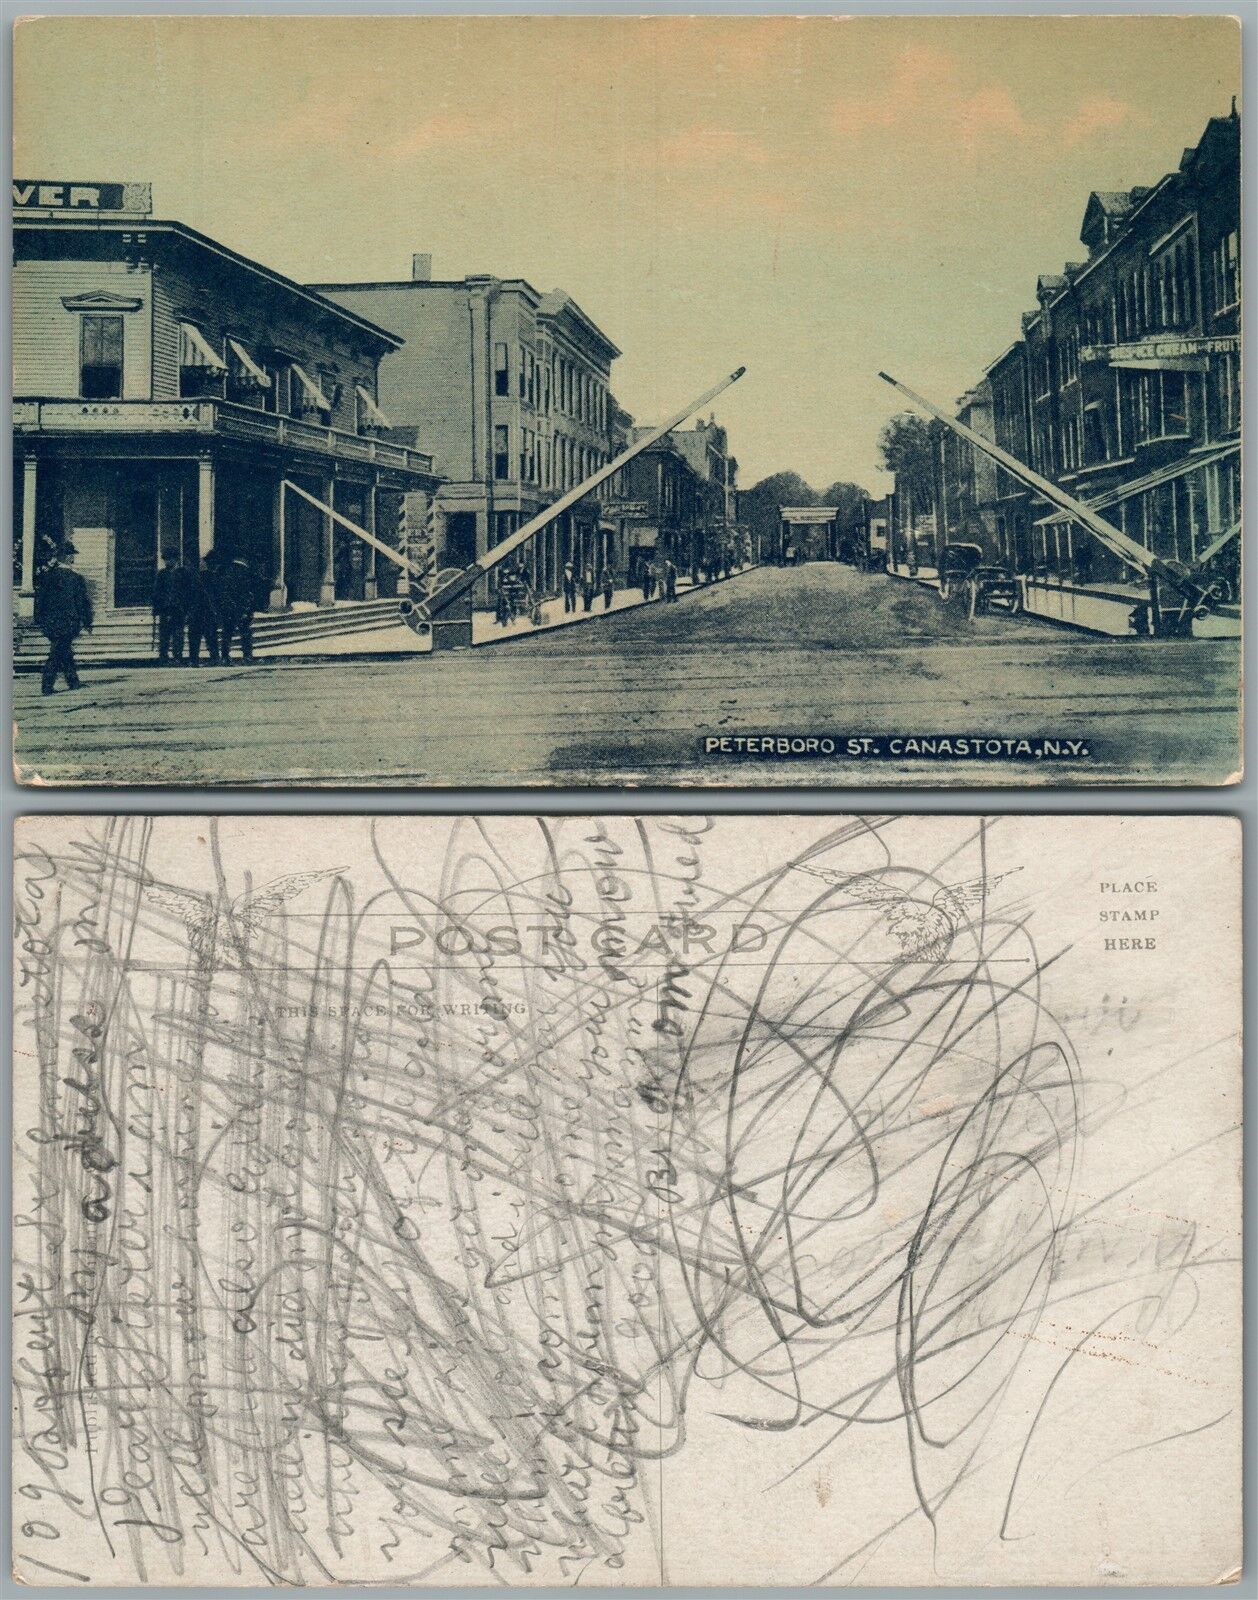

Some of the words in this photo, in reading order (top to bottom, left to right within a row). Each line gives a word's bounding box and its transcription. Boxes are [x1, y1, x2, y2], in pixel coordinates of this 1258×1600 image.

[1100, 881, 1158, 893] PLACE
[1099, 909, 1160, 921] STAMP
[390, 925, 554, 957] POST
[590, 923, 769, 957] CARD
[1104, 938, 1157, 951] HERE
[274, 1006, 319, 1019] THIS
[327, 1005, 387, 1018] SPACE
[395, 1004, 434, 1017] FOR
[442, 1002, 527, 1016] WRITING
